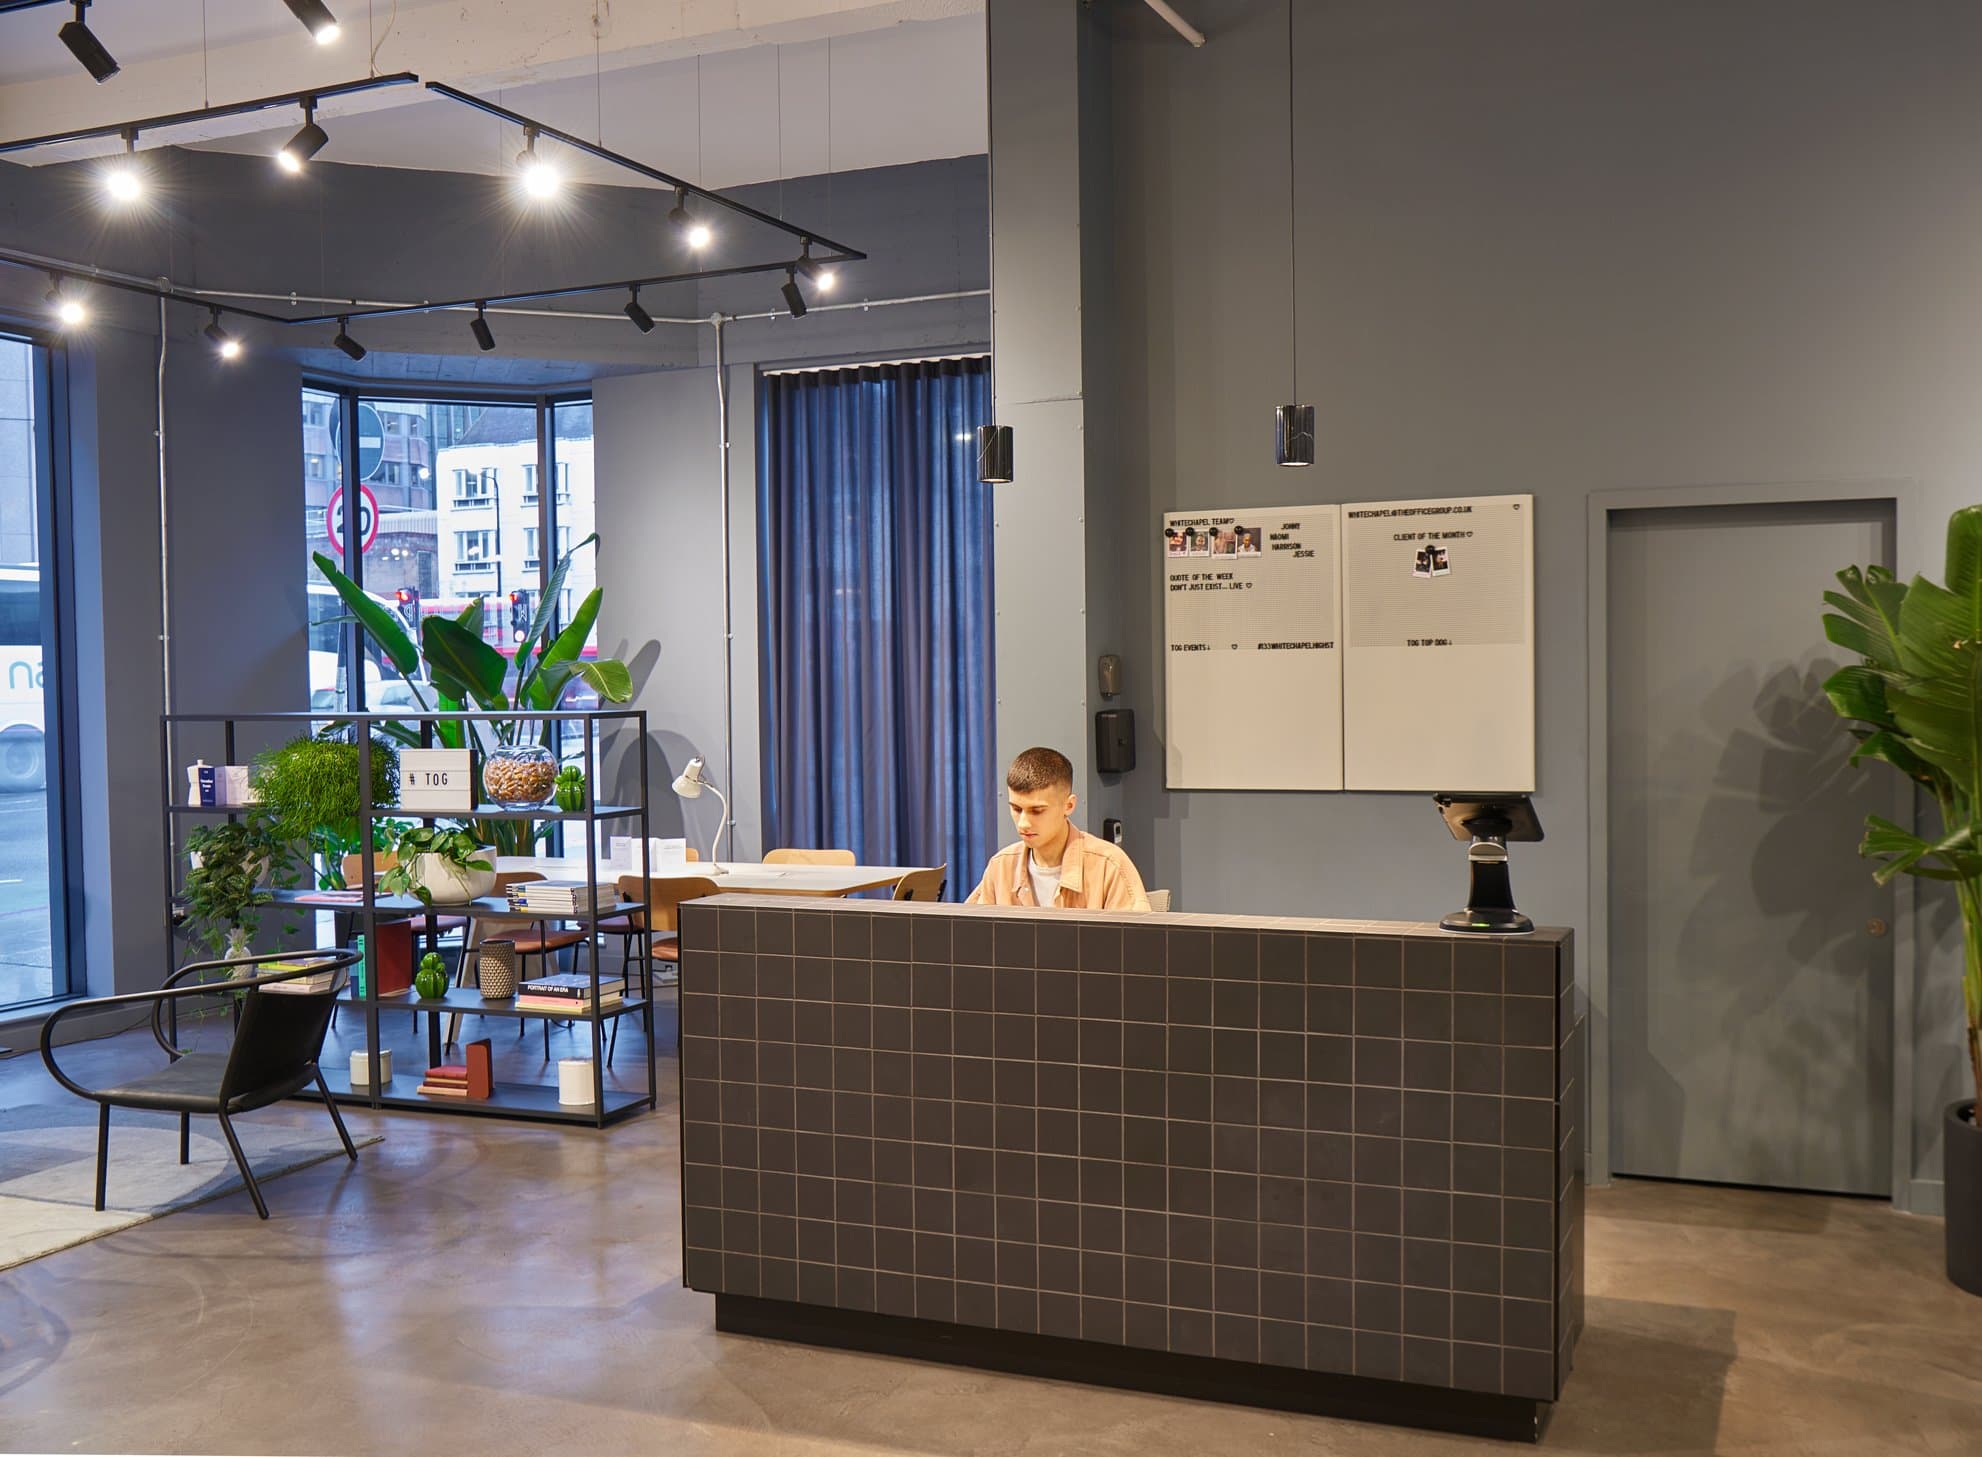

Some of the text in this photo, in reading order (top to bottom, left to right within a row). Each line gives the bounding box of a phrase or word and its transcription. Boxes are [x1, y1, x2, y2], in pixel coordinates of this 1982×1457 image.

[1393, 533, 1415, 541] CLIENT
[1417, 532, 1425, 540] OF
[1442, 531, 1465, 539] MONTH
[1229, 582, 1243, 590] LIVE
[1407, 639, 1419, 647] TOG
[425, 772, 448, 786] TOG
